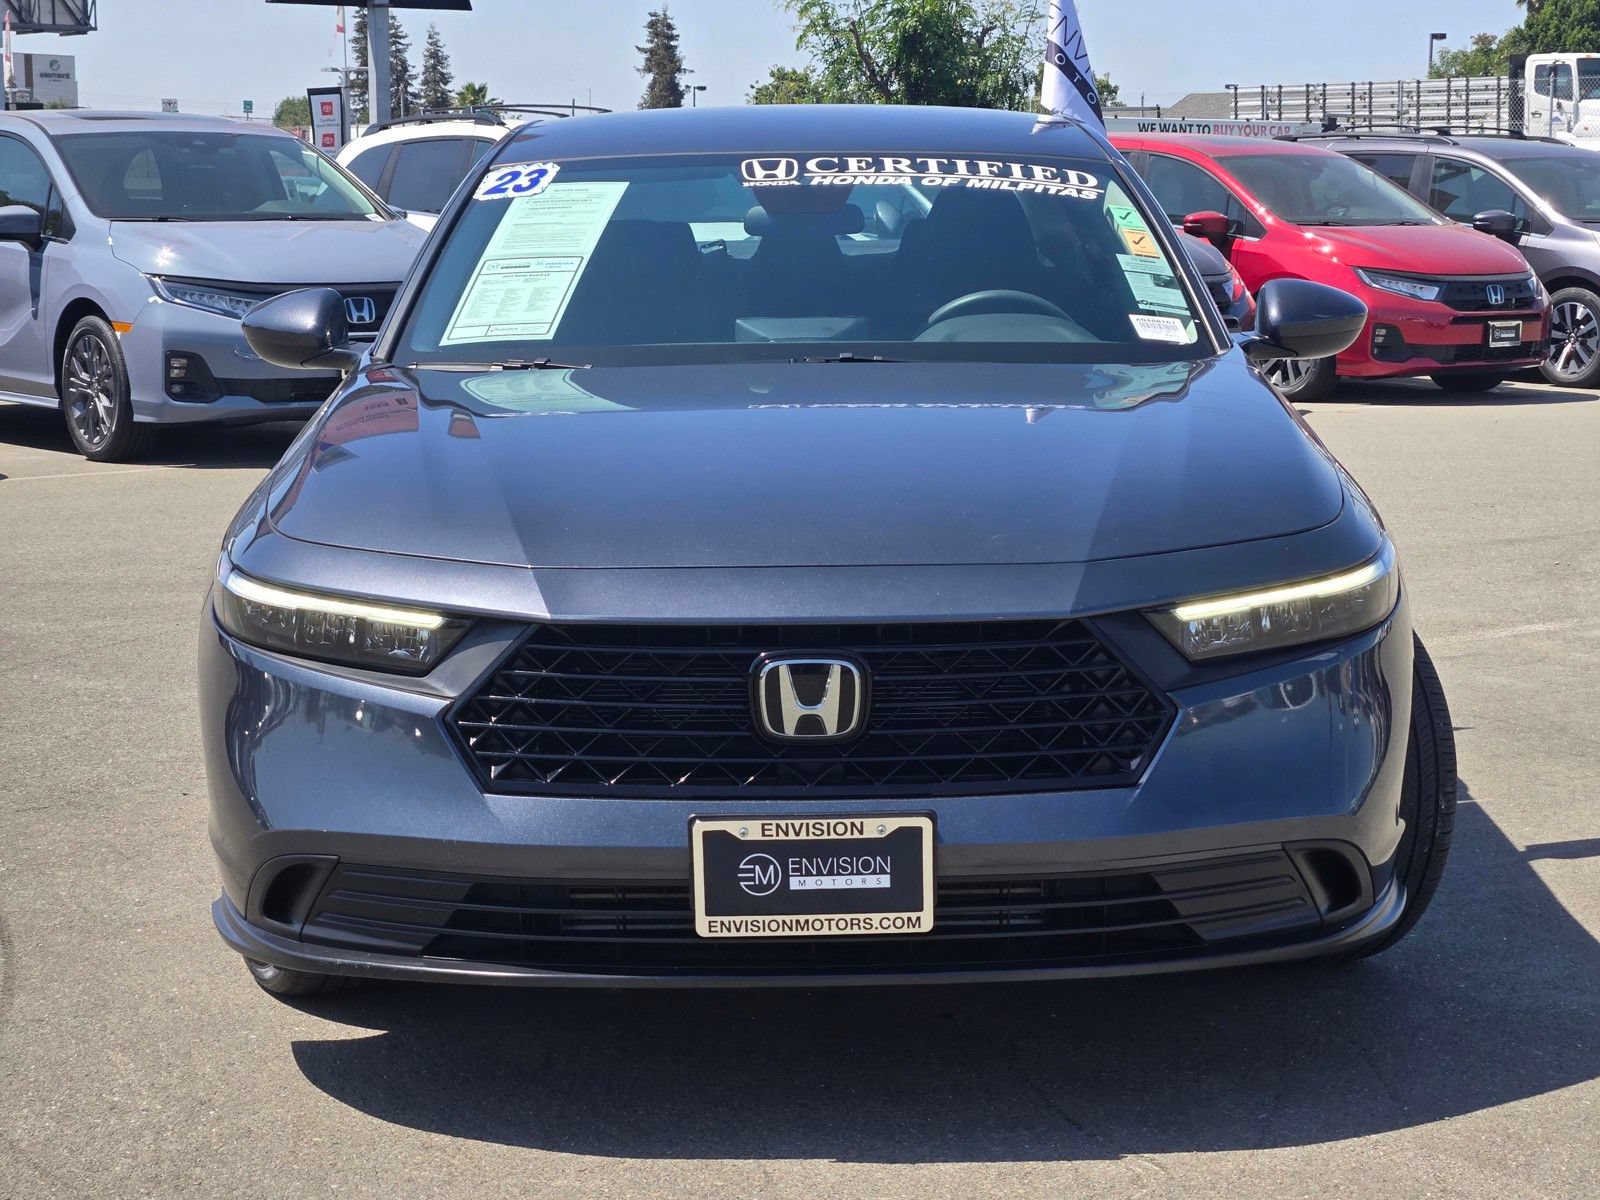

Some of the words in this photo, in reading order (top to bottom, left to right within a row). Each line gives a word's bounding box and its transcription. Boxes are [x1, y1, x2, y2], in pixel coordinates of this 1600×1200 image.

[1138, 122, 1156, 132] WE
[1159, 123, 1195, 133] WANT
[1196, 124, 1211, 134] TO
[1213, 124, 1235, 136] BUY
[1237, 125, 1267, 137] YOUR
[1269, 126, 1291, 137] CAR
[805, 156, 1099, 188] CERTIFIED
[482, 168, 549, 196] 23
[742, 178, 802, 187] HONDA
[810, 174, 913, 187] HONDA
[921, 176, 961, 188] OF
[970, 177, 1100, 200] MILPITAS
[761, 821, 864, 838] ENVISION
[788, 856, 891, 875] ENVISION
[798, 877, 882, 887] MOTORS
[708, 916, 922, 933] ENVISIONMOTORS.COM
